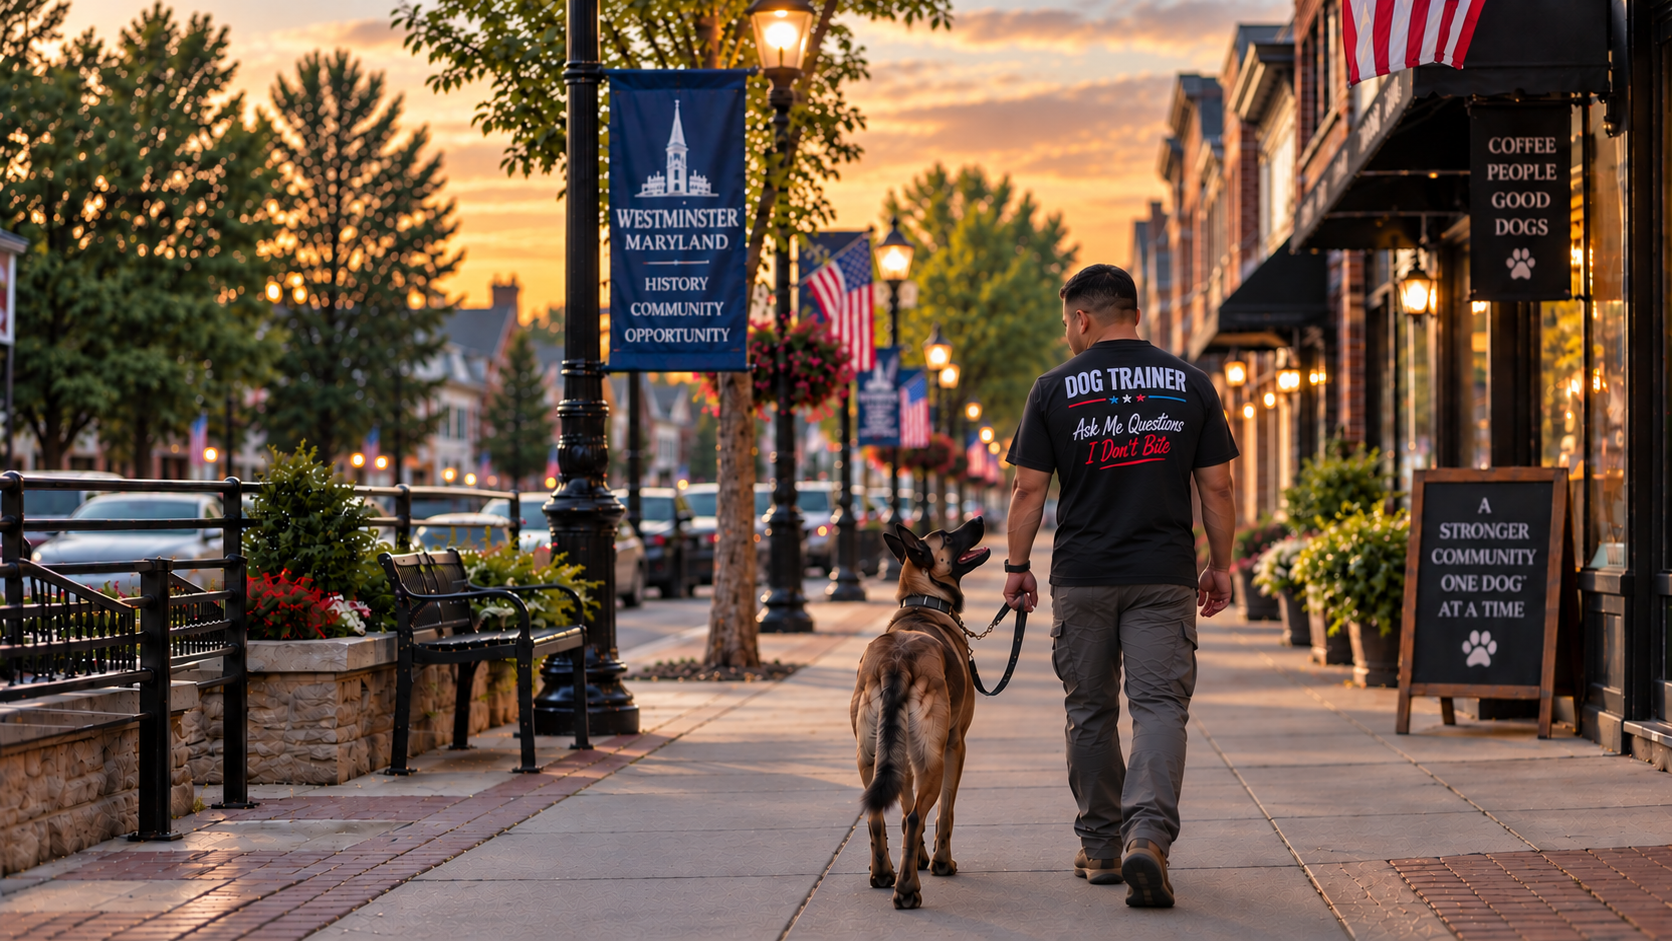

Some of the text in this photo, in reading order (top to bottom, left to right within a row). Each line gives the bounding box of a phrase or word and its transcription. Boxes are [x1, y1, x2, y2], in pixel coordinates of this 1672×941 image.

[1488, 137, 1557, 154] COFFEE
[1487, 163, 1557, 181] PEOPLE
[1491, 191, 1551, 209] GOOD
[616, 208, 739, 228] WESTMINSTER
[1495, 218, 1549, 236] DOGS
[625, 234, 729, 251] MARYLAND
[645, 277, 708, 291] HISTORY
[630, 301, 724, 317] COMMUNITY
[625, 328, 730, 343] OPPORTUNITY
[1064, 366, 1187, 399] DOG TRAINER
[1073, 412, 1184, 440] Ask Me Questions
[1085, 434, 1171, 465] I Don't Bite
[1477, 497, 1492, 514] A
[1439, 522, 1530, 540] STRONGER
[1431, 548, 1537, 565] COMMUNITY
[1441, 574, 1478, 592] ONE
[1438, 601, 1525, 618] AT A TIME
